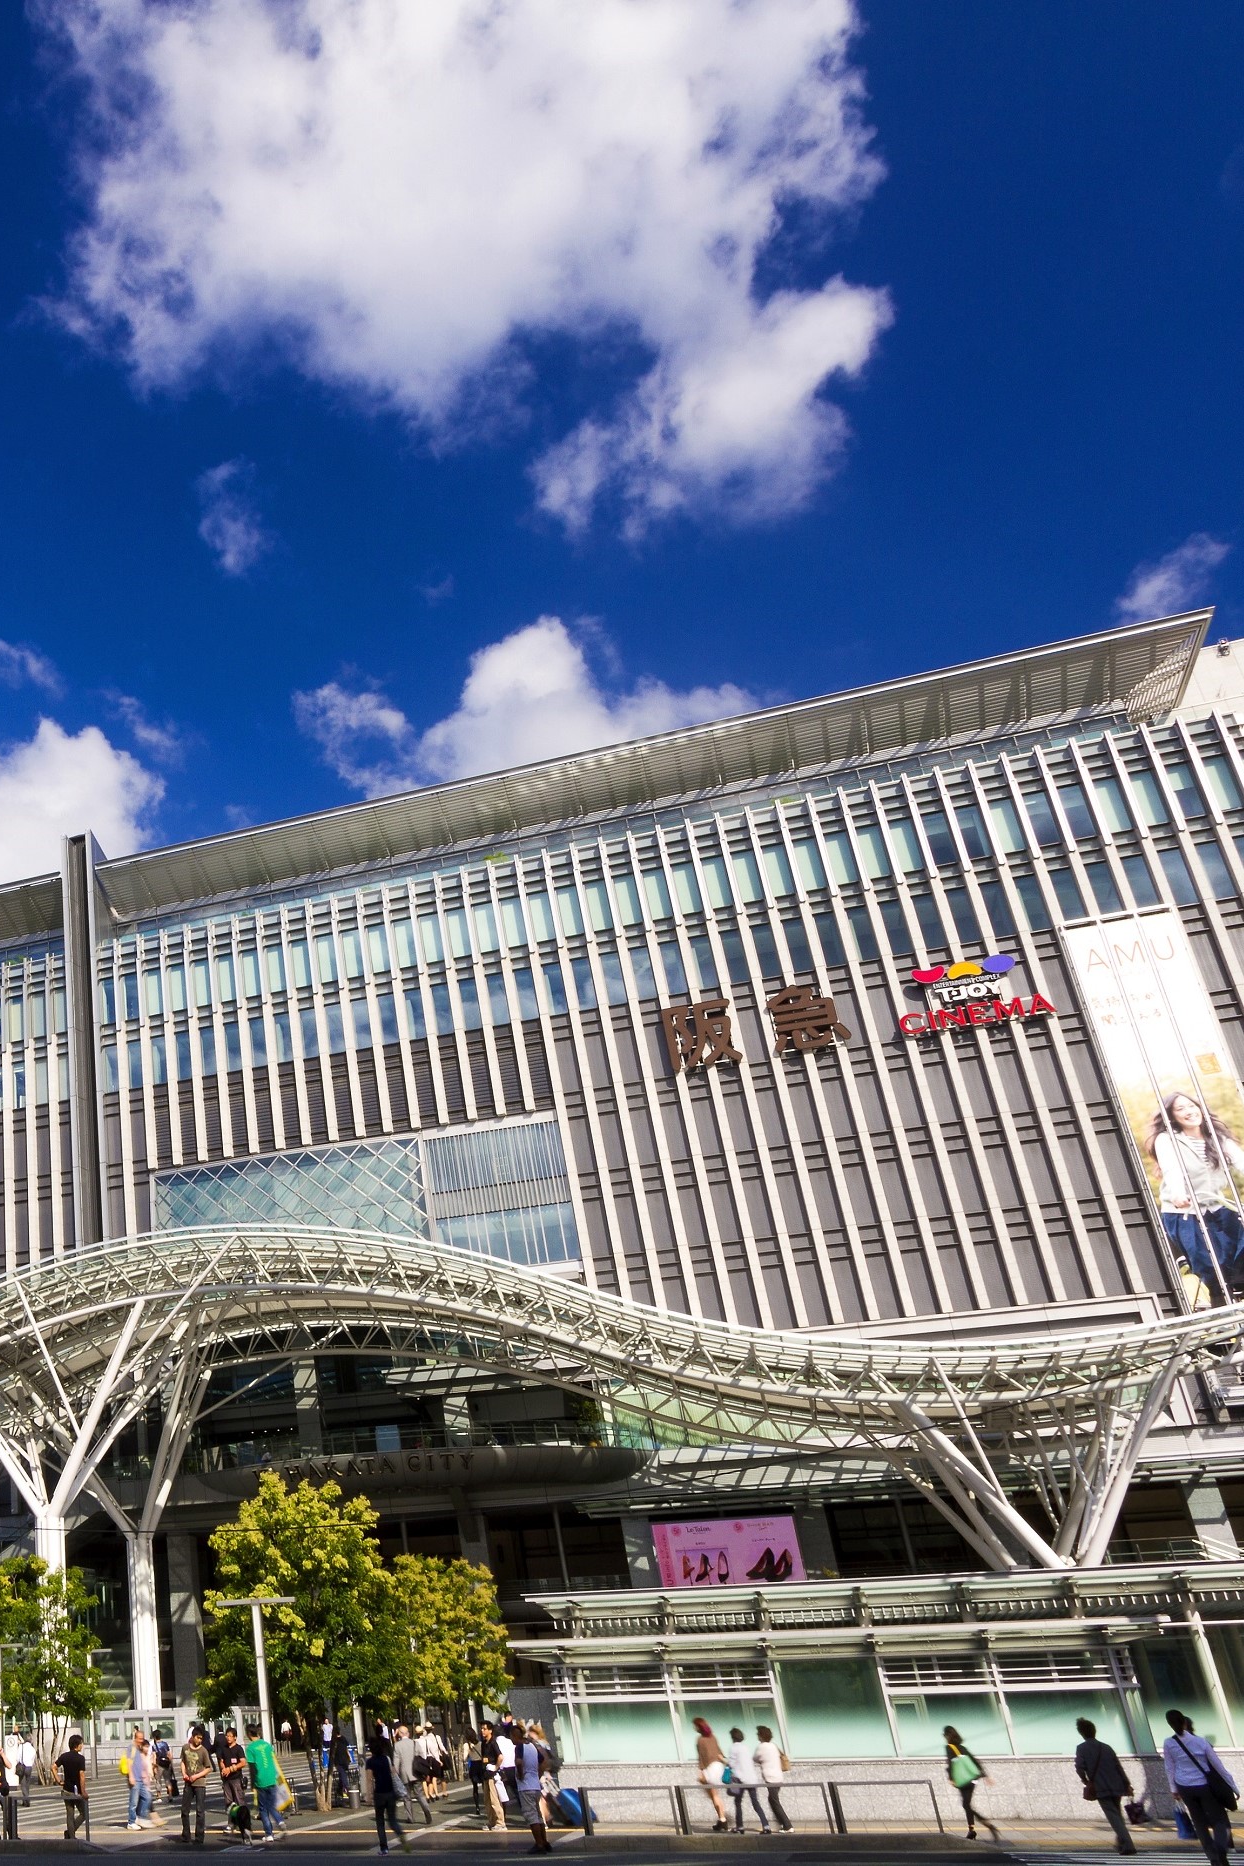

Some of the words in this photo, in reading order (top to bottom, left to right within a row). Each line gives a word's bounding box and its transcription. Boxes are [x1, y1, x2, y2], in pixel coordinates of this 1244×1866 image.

[1087, 935, 1175, 973] AMU
[975, 973, 1001, 984] COMPLEX
[661, 984, 852, 1072] 阪急
[899, 993, 1056, 1034] CINEMA
[283, 1455, 397, 1482] HAKATA
[408, 1452, 475, 1473] CITY
